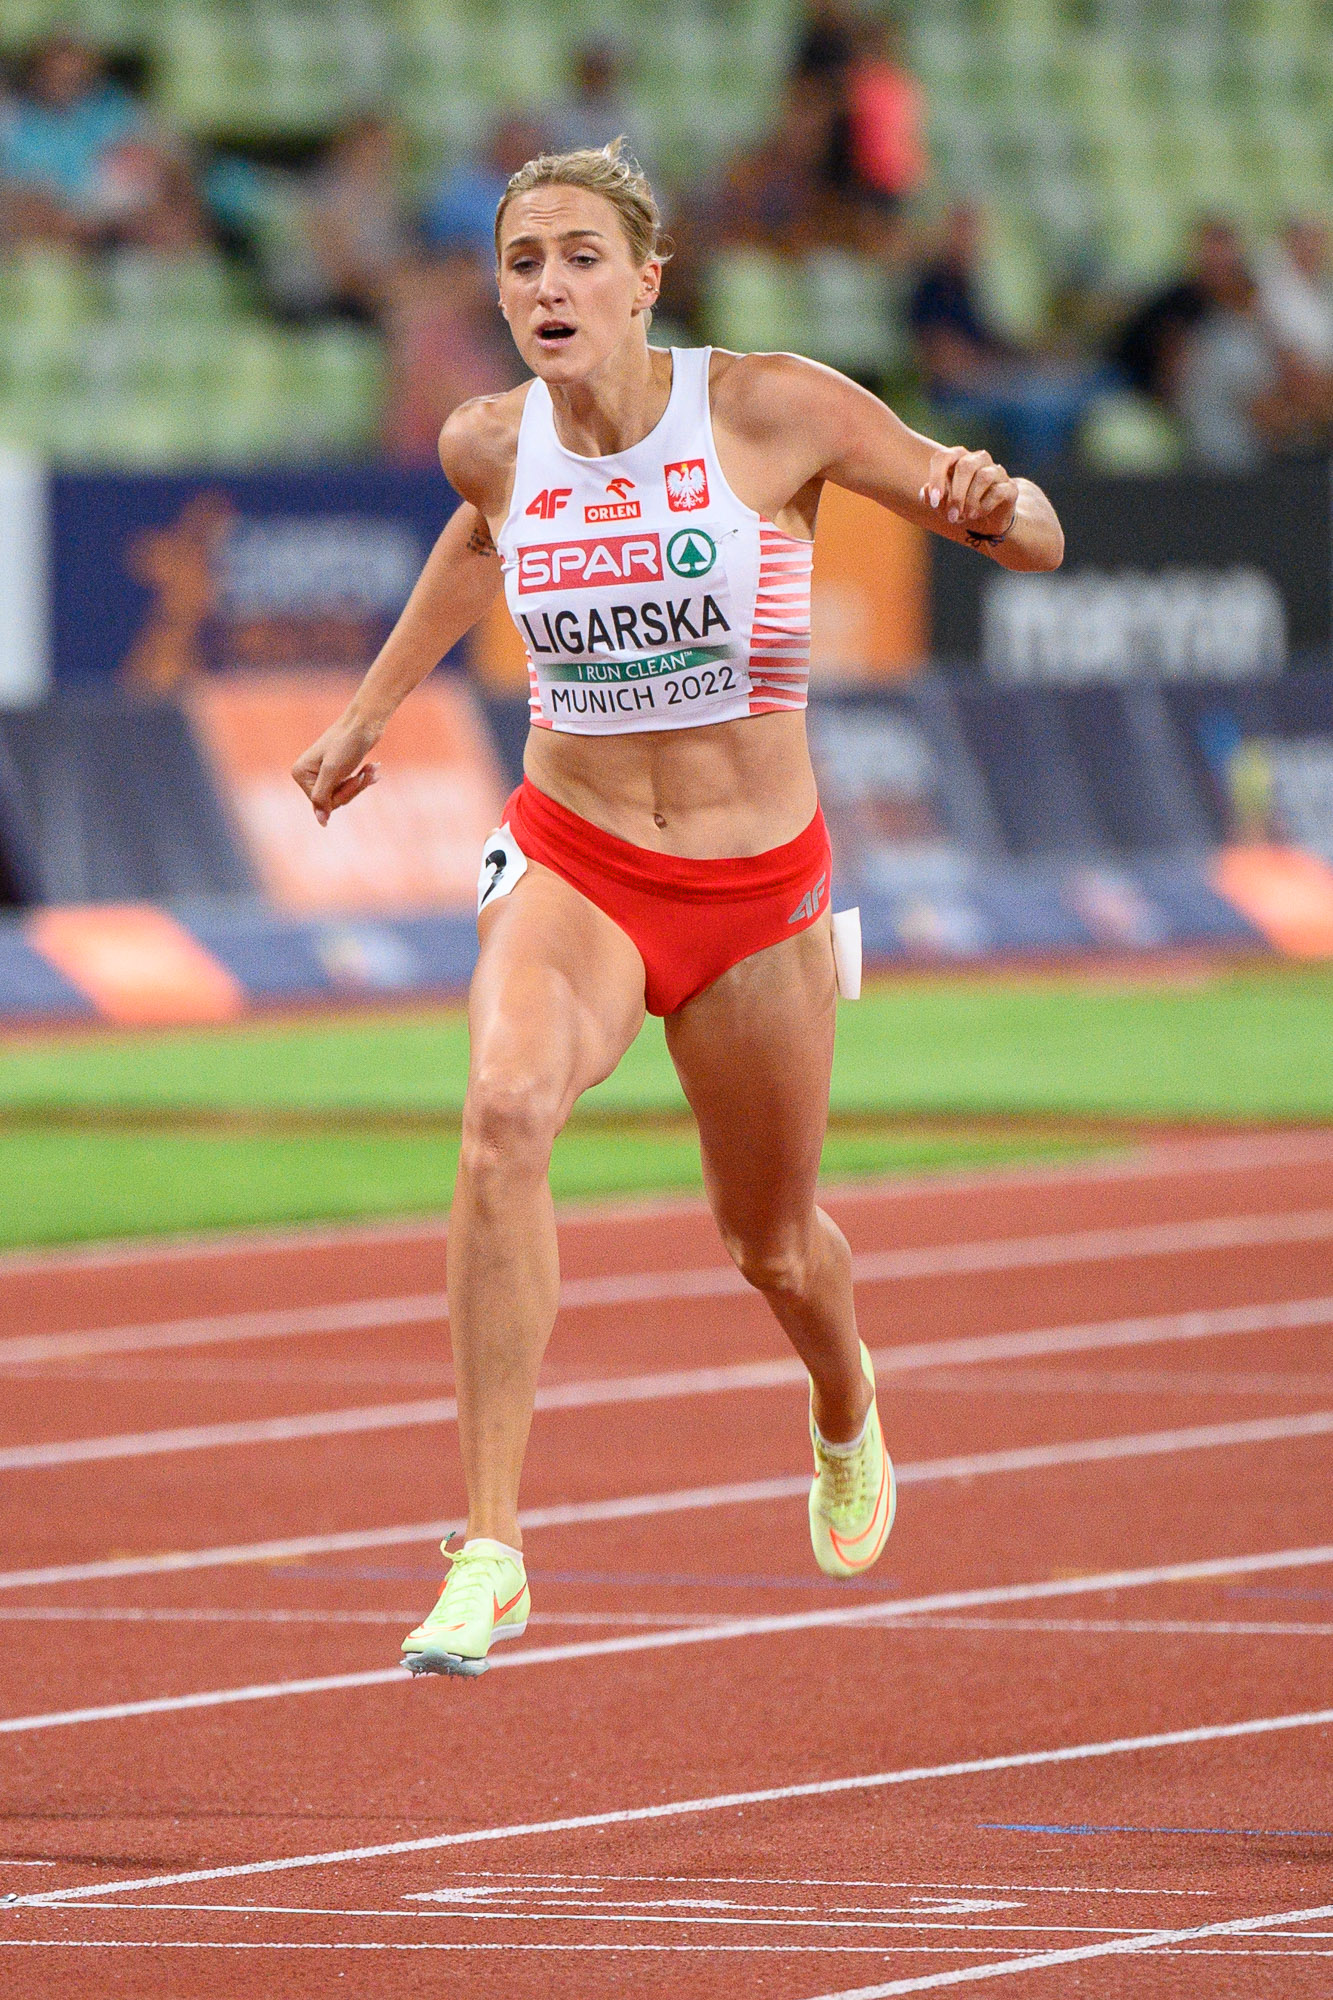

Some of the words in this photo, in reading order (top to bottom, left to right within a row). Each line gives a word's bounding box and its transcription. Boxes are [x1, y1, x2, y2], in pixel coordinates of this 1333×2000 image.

[525, 488, 573, 519] 4F
[587, 504, 638, 521] ORLEN
[521, 541, 659, 587] SPAR
[521, 594, 731, 655] LIGARSKA
[551, 686, 655, 714] MUNICH
[664, 666, 736, 705] 2022
[578, 667, 583, 680] I
[587, 664, 621, 681] RUN
[787, 872, 826, 924] 4F
